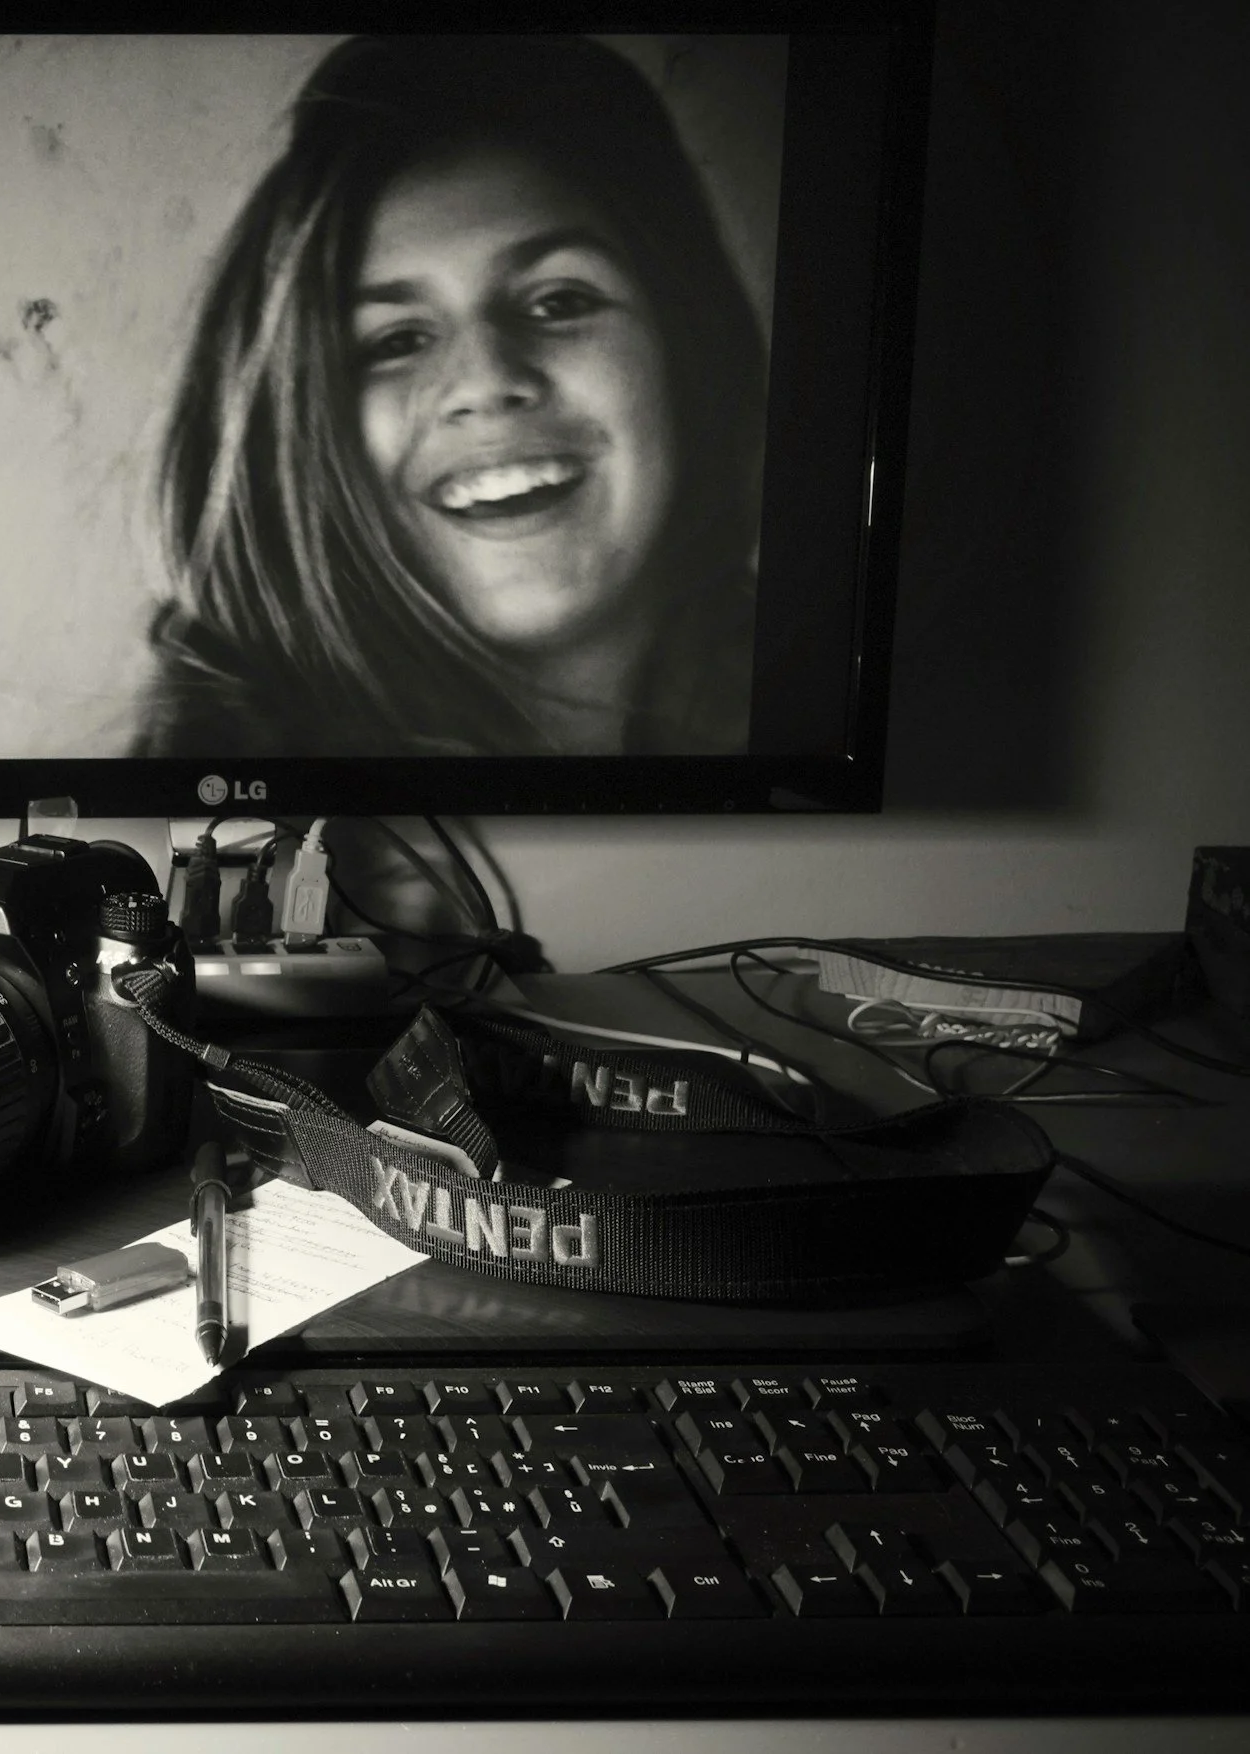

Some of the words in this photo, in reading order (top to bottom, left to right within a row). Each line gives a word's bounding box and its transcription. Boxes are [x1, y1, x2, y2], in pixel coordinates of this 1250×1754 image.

[234, 781, 267, 800] LG
[544, 1055, 690, 1116] PEN
[370, 1155, 600, 1269] PENTAX
[678, 1380, 715, 1389] Stamp
[752, 1379, 778, 1387] Bloc
[820, 1377, 858, 1386] Pausa
[35, 1388, 53, 1396] F5
[375, 1386, 395, 1395] F9
[445, 1386, 469, 1395] F10
[517, 1385, 541, 1394] F11
[589, 1385, 613, 1394] F12
[758, 1387, 789, 1395] Scorr
[826, 1386, 857, 1394] Interr
[851, 1412, 881, 1423] Pag
[710, 1420, 734, 1429] Ins
[953, 1422, 985, 1431] Num
[19, 1432, 31, 1442] 6
[95, 1431, 107, 1441] 7
[171, 1432, 182, 1442] 8
[246, 1432, 258, 1441] 9
[878, 1446, 909, 1457] Pag
[132, 1456, 147, 1467] U
[287, 1454, 303, 1465] O
[367, 1454, 381, 1464] P
[804, 1452, 837, 1462] Fine
[56, 1457, 73, 1469] Y
[588, 1463, 617, 1472] Invio
[4, 1496, 23, 1509] G
[84, 1496, 100, 1507] H
[165, 1496, 177, 1508] J
[238, 1494, 256, 1507] K
[322, 1494, 336, 1505] L
[48, 1534, 65, 1547] B
[136, 1532, 152, 1544] N
[213, 1532, 231, 1544] M
[1049, 1536, 1082, 1546] Fine
[370, 1578, 395, 1588] Alt
[397, 1577, 418, 1588] Gr
[693, 1575, 720, 1586] Ctrl
[1081, 1578, 1106, 1588] Ins
